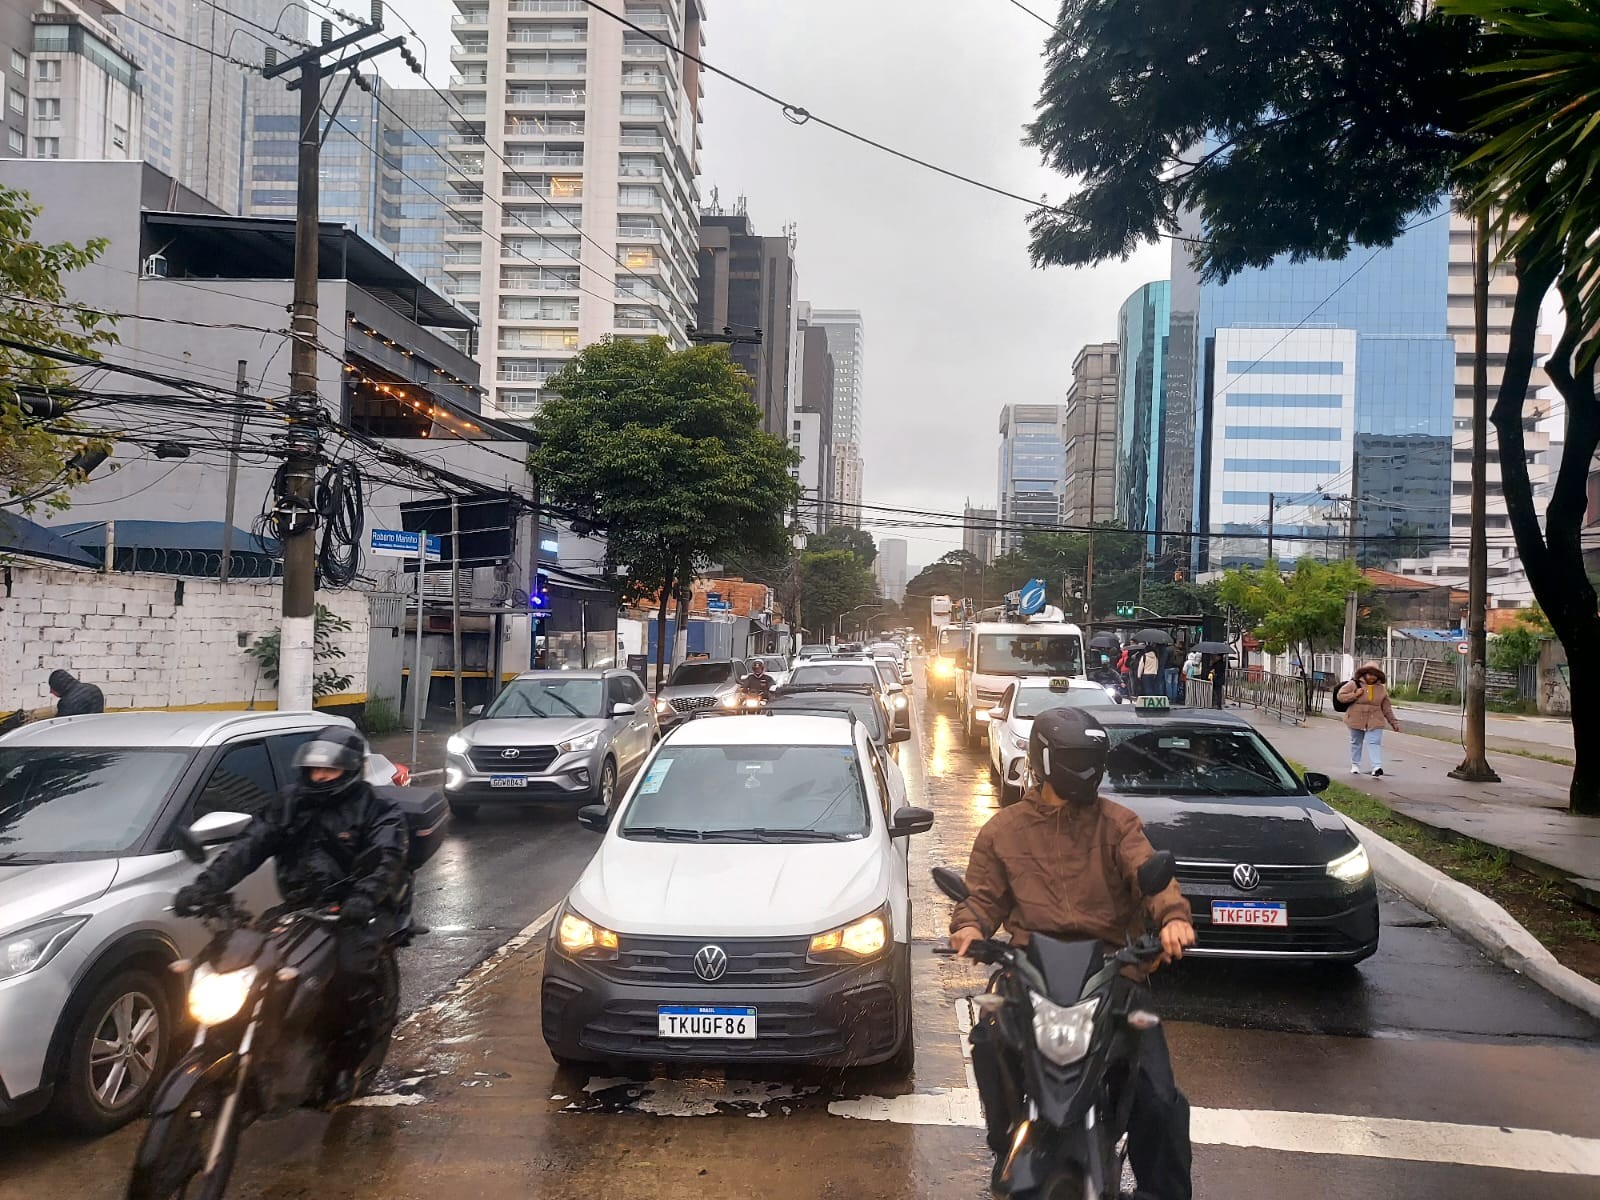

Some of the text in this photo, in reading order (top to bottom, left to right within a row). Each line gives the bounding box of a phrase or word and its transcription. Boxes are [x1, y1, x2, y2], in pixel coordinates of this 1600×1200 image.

[373, 532, 394, 542] Roberto
[395, 534, 418, 543] Marinho
[1051, 679, 1067, 687] TAXI
[1141, 697, 1166, 708] TAXI
